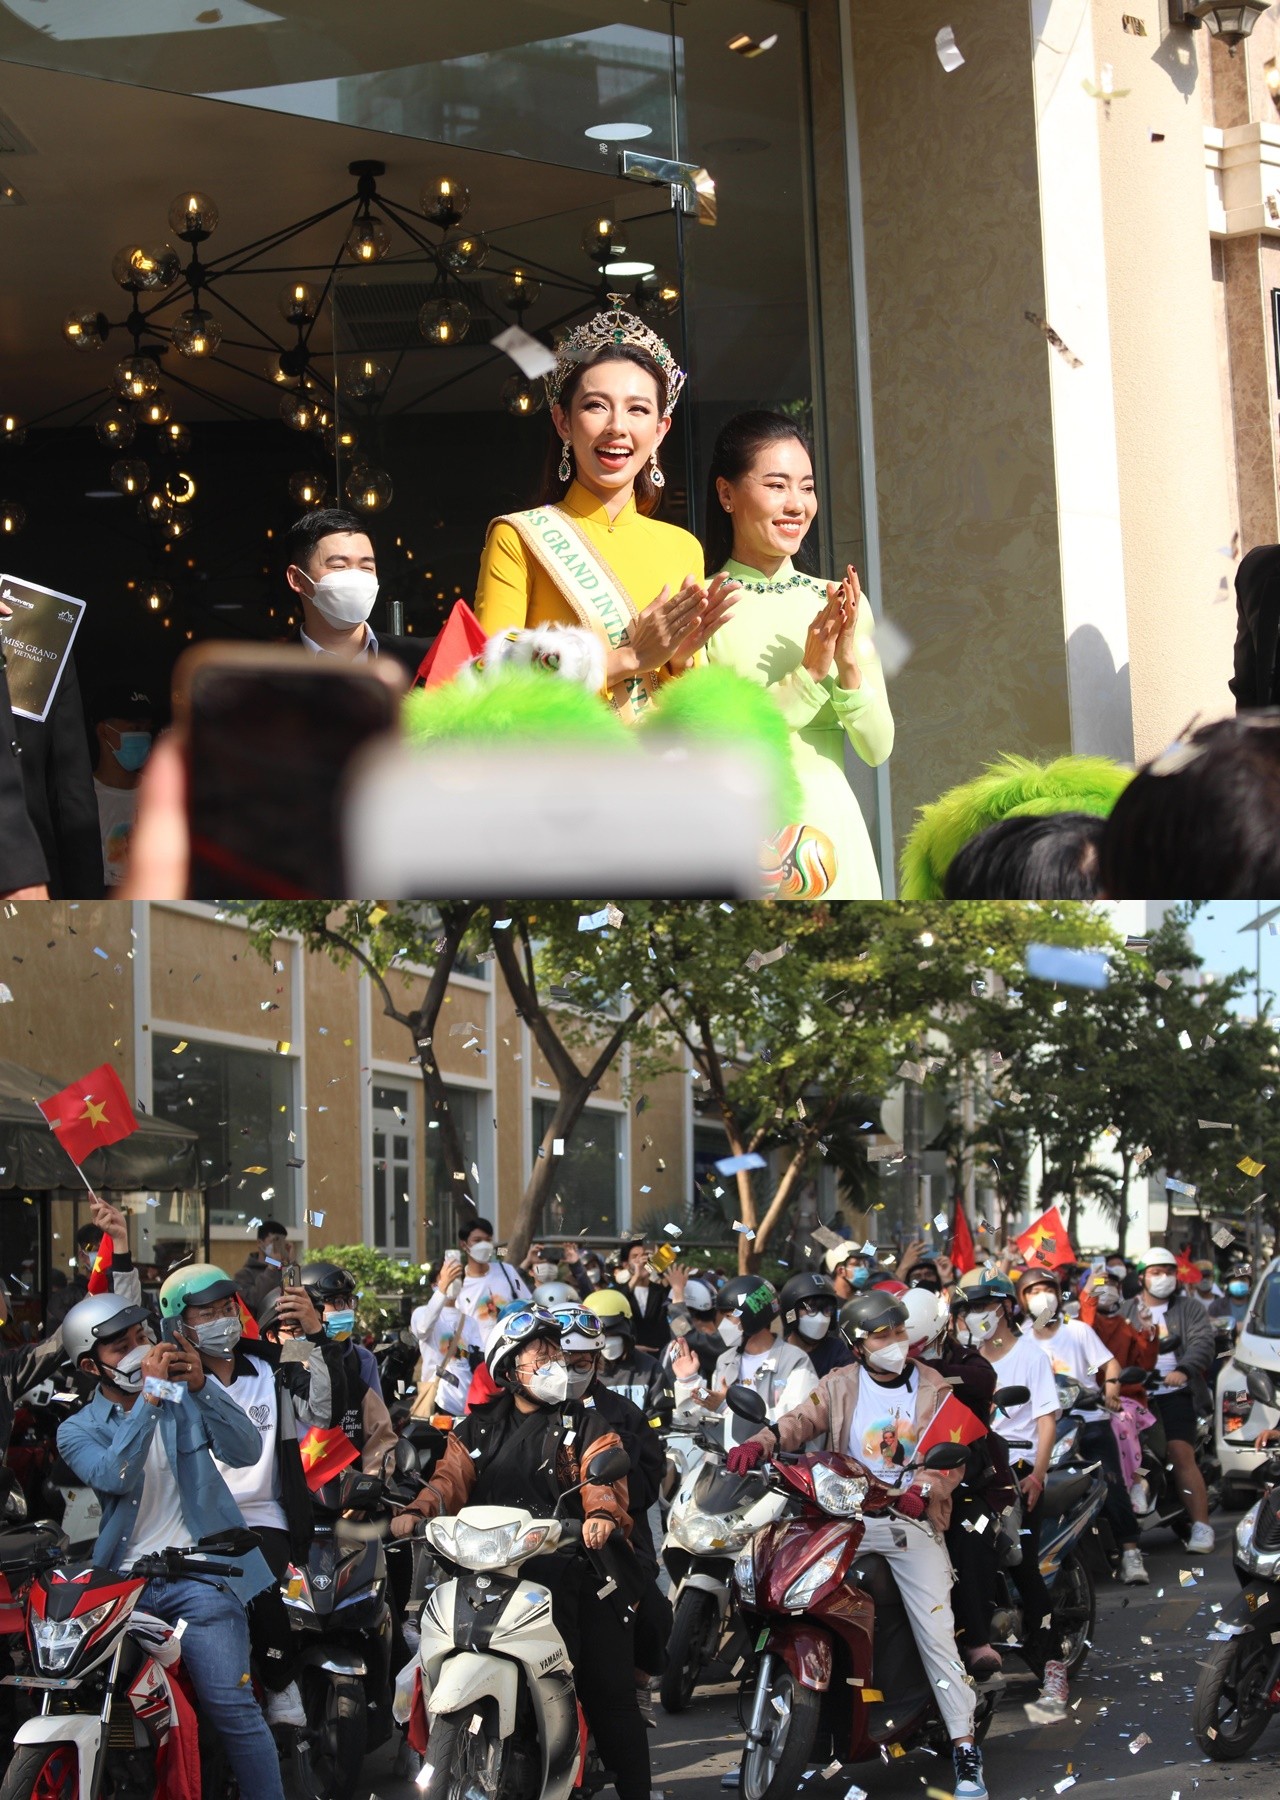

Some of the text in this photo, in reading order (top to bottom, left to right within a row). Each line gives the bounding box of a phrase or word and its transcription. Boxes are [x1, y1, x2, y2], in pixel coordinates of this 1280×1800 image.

[542, 529, 599, 590] GRAND
[3, 637, 58, 660] MISS GRAND
[14, 649, 43, 663] VIETNAM
[539, 1648, 564, 1671] YAMAHA
